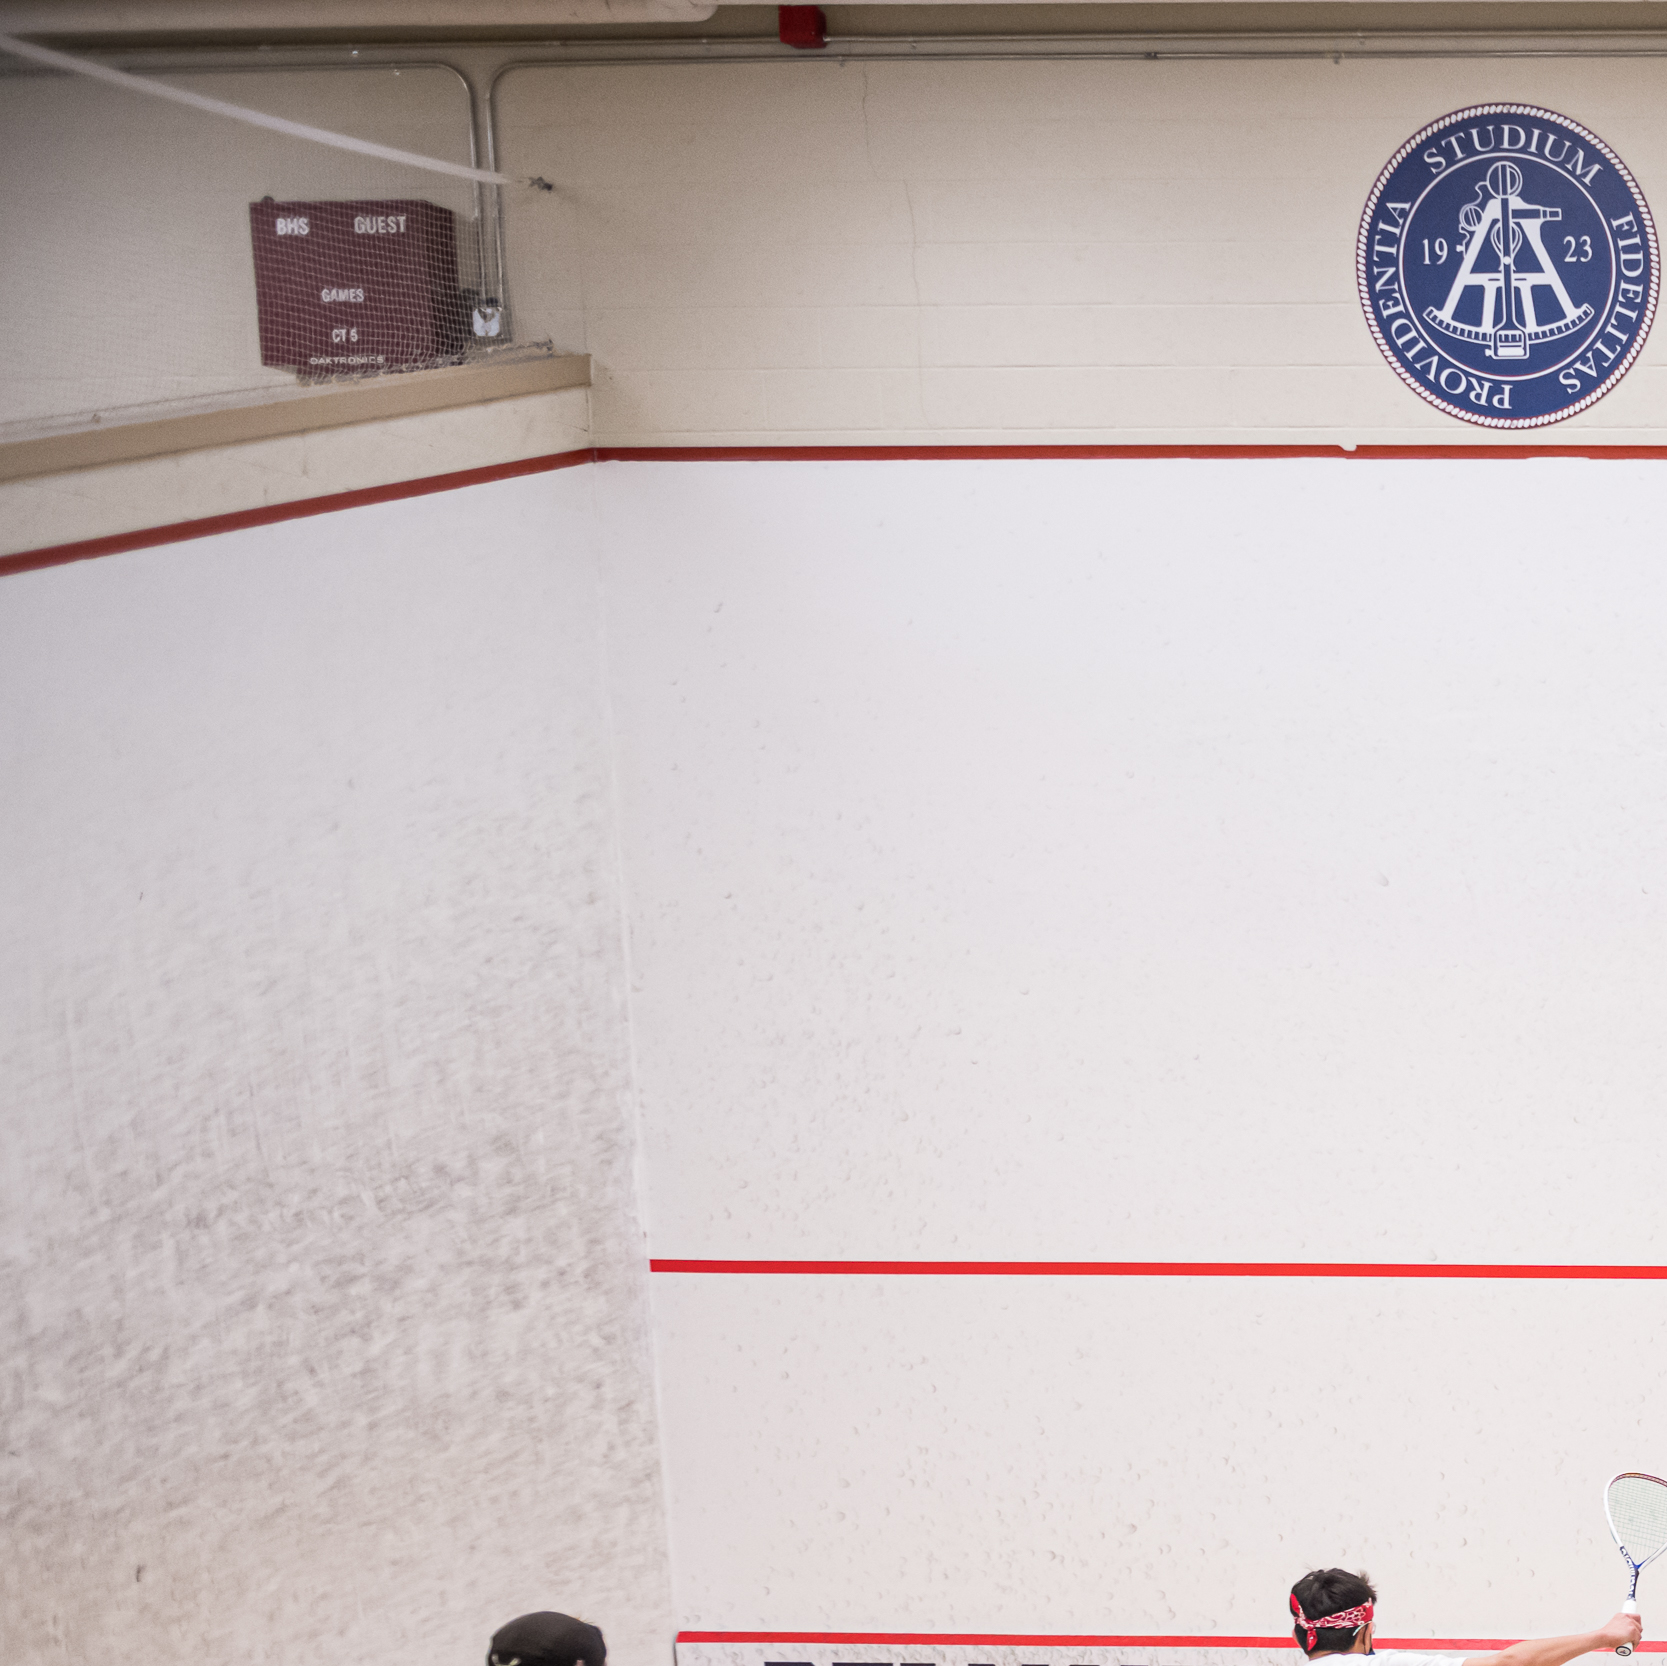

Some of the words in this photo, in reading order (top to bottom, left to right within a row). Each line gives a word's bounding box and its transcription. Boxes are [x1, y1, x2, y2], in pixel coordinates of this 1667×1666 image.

[1423, 124, 1603, 187] STUDIUM
[276, 217, 309, 235] BHS
[354, 215, 406, 234] GUEST
[1422, 237, 1448, 265] 19
[1563, 235, 1593, 263] 23
[322, 288, 364, 303] GAMES
[1373, 200, 1513, 409] PROVIDENTIA
[1559, 212, 1644, 394] FIDELITAS
[332, 329, 347, 342] CT
[310, 355, 384, 365] DAKTRONICS
